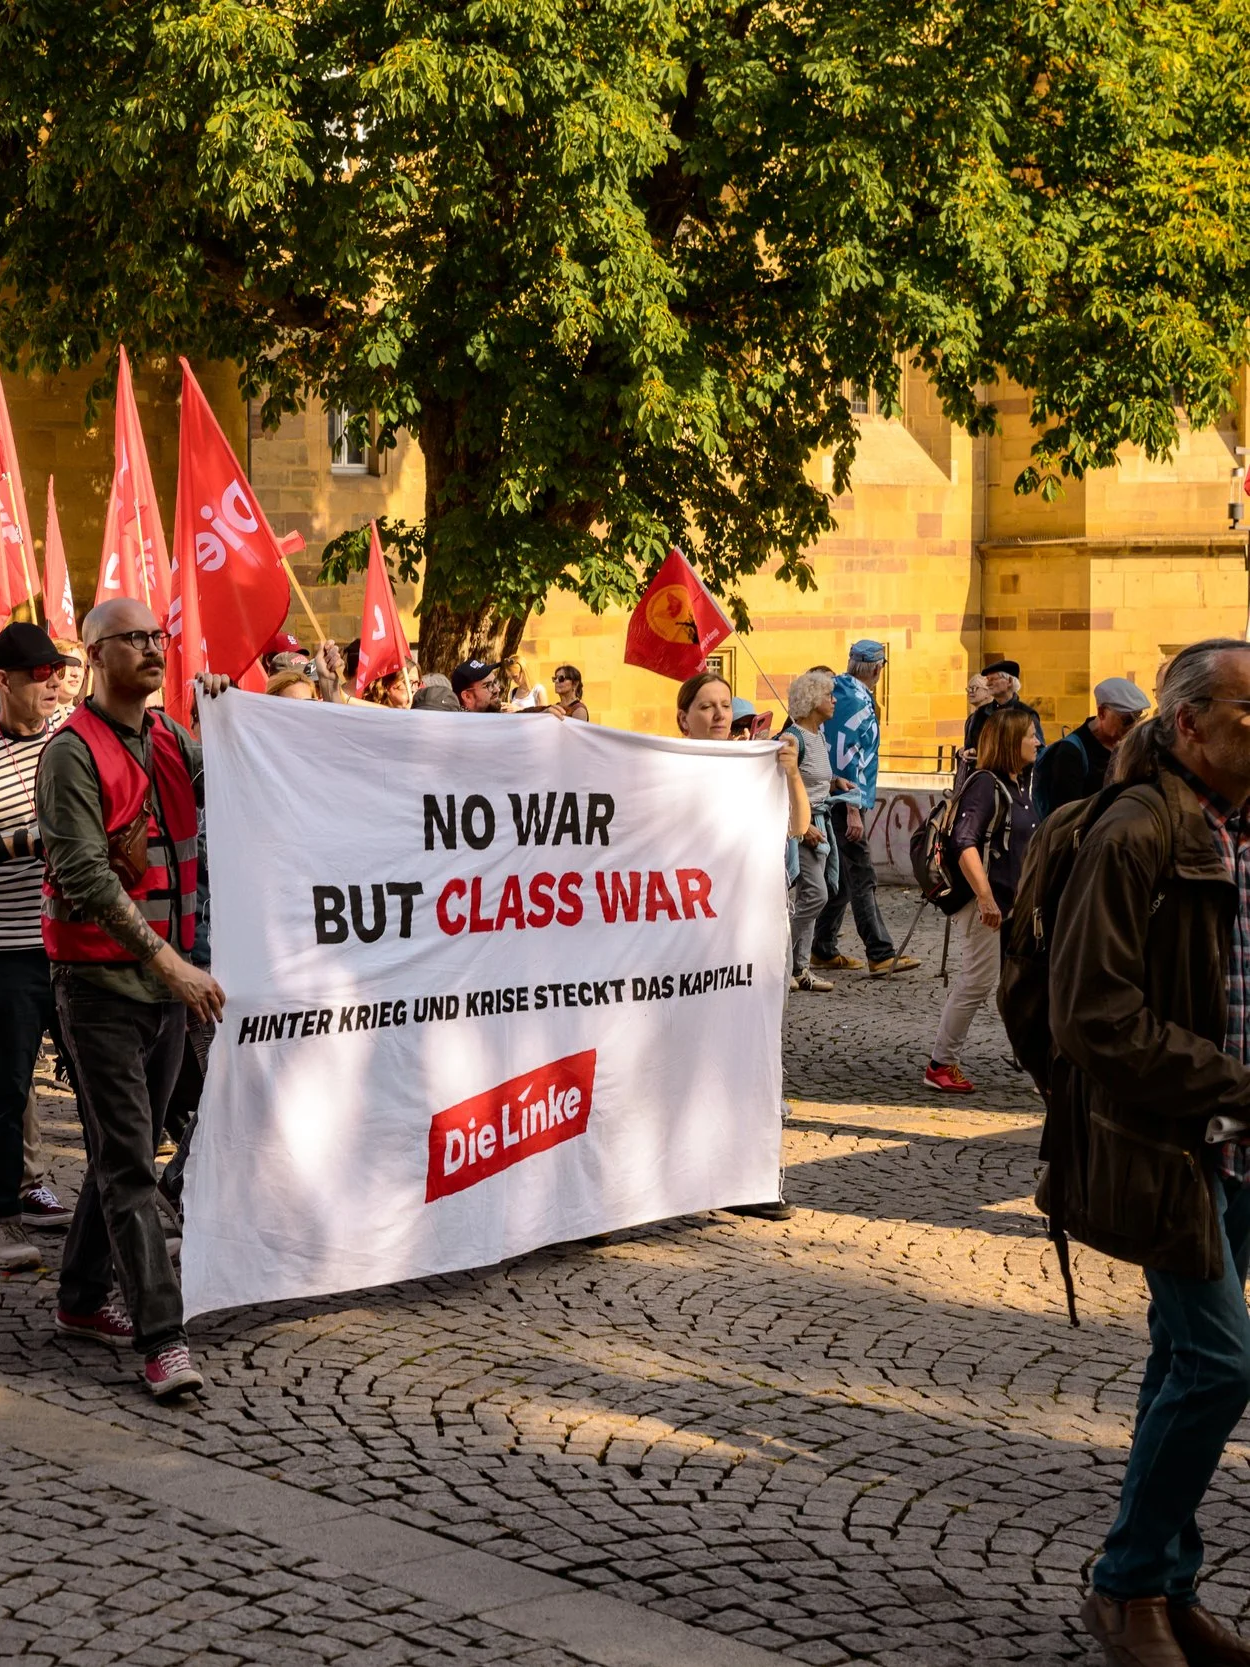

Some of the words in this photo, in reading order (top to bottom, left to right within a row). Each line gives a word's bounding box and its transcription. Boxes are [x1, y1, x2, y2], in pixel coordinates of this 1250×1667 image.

[423, 794, 495, 850] NO
[507, 792, 615, 847] WAR
[312, 881, 424, 944] BUT
[436, 871, 584, 936] CLASS
[595, 868, 718, 924] WAR
[238, 1008, 333, 1045] HINTER
[338, 1001, 407, 1033] KRIEG
[414, 995, 460, 1023] UND
[465, 987, 529, 1017] KRISE
[533, 979, 626, 1010] STECKT
[632, 975, 675, 1001] DAS
[678, 963, 754, 997] KAPITAL!
[443, 1116, 497, 1177] Die
[502, 1081, 582, 1149] Linke
